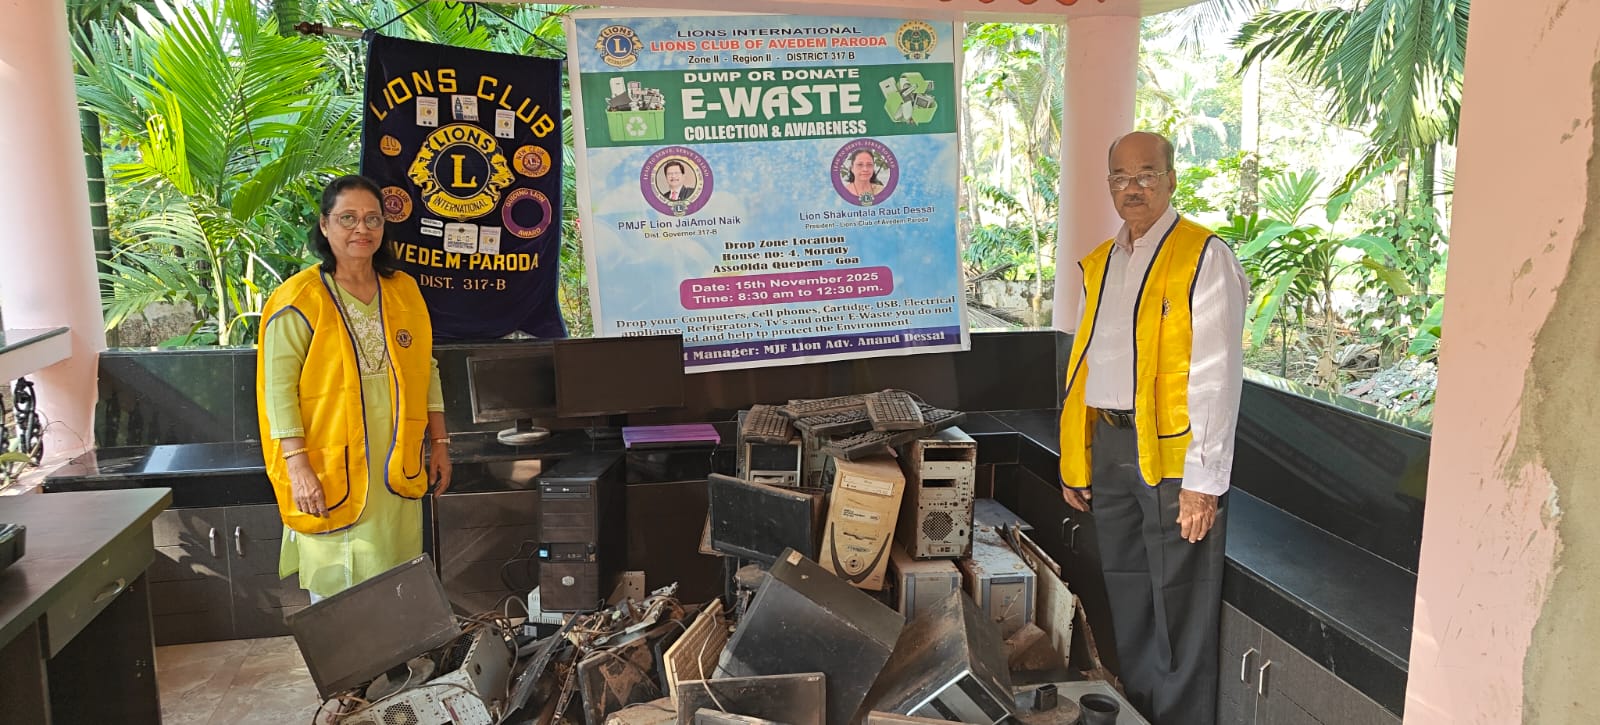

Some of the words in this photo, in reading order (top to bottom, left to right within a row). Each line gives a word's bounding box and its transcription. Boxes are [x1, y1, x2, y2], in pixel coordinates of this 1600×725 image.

[677, 29, 727, 38] LIONS
[732, 27, 862, 36] INTERNATIONAL
[613, 38, 627, 54] L
[650, 41, 696, 52] LIONS
[701, 39, 740, 50] CLUB
[745, 38, 764, 49] OF
[768, 37, 827, 49] AVEDEM
[831, 36, 888, 47] PARODA
[688, 55, 711, 64] Zone
[732, 54, 762, 63] Region
[787, 52, 829, 61] DISTRICT
[831, 52, 846, 60] 317
[848, 52, 855, 60] B
[684, 72, 741, 83] DUMP
[748, 71, 776, 81] OR
[782, 69, 860, 80] DONATE
[369, 69, 457, 121] LIONS
[477, 75, 555, 139] CLUB
[681, 83, 863, 121] E-WASTE
[433, 128, 492, 151] LIONS
[684, 124, 768, 141] COLLECTION
[771, 125, 782, 137] &
[784, 120, 867, 137] AWARENESS
[451, 154, 478, 188] L
[432, 194, 489, 214] INTERNATIONAL
[800, 212, 821, 221] Lion
[823, 208, 876, 219] Shakuntala
[879, 207, 901, 216] Raut
[904, 205, 935, 214] Dessai
[518, 228, 541, 237] AWARD
[618, 221, 647, 231] PMJF
[650, 219, 673, 229] Lion
[675, 217, 717, 228] JaiAmol
[718, 215, 742, 225] Naik
[805, 222, 835, 230] President
[724, 240, 756, 252] Drop
[759, 238, 788, 248] Zone
[792, 235, 846, 247] Location
[390, 240, 539, 272] VEDEM-PARODA
[722, 251, 761, 262] House
[764, 249, 784, 258] no:
[804, 245, 849, 258] Morddy
[772, 259, 824, 270] Quepem
[835, 256, 860, 266] Goa
[419, 273, 455, 290] DIST.
[463, 278, 506, 291] 317-B
[692, 283, 730, 294] Date:
[735, 278, 766, 291] 15th
[770, 276, 842, 289] November
[846, 272, 879, 283] 2025
[693, 295, 734, 305] Time:
[738, 290, 769, 302] 8:30
[772, 291, 795, 299] am
[798, 288, 812, 298] to
[817, 285, 854, 297] 12:30
[857, 283, 884, 295] pm.
[616, 319, 647, 330] Drop
[650, 317, 678, 328] your
[681, 312, 749, 327] Computers,
[751, 310, 773, 318] Cell
[776, 306, 820, 318] phones,
[823, 302, 873, 315] Cartidge,
[876, 299, 901, 309] USB,
[904, 295, 955, 307] Electrical
[687, 321, 761, 334] Refrigrators,
[790, 314, 811, 325] and
[815, 313, 844, 324] other
[848, 309, 892, 320] E-Waste
[895, 308, 915, 318] you
[918, 306, 932, 315] do
[934, 304, 953, 314] not
[684, 333, 699, 343] ed
[702, 332, 724, 343] and
[727, 330, 751, 342] help
[771, 325, 812, 338] protect
[815, 323, 834, 333] the
[836, 318, 912, 332] Environment.
[693, 346, 759, 361] Manager:
[763, 341, 788, 354] MJF
[791, 339, 821, 352] Lion
[825, 337, 854, 350] Adv.
[857, 333, 900, 347] Anand
[904, 331, 945, 342] Dessai
